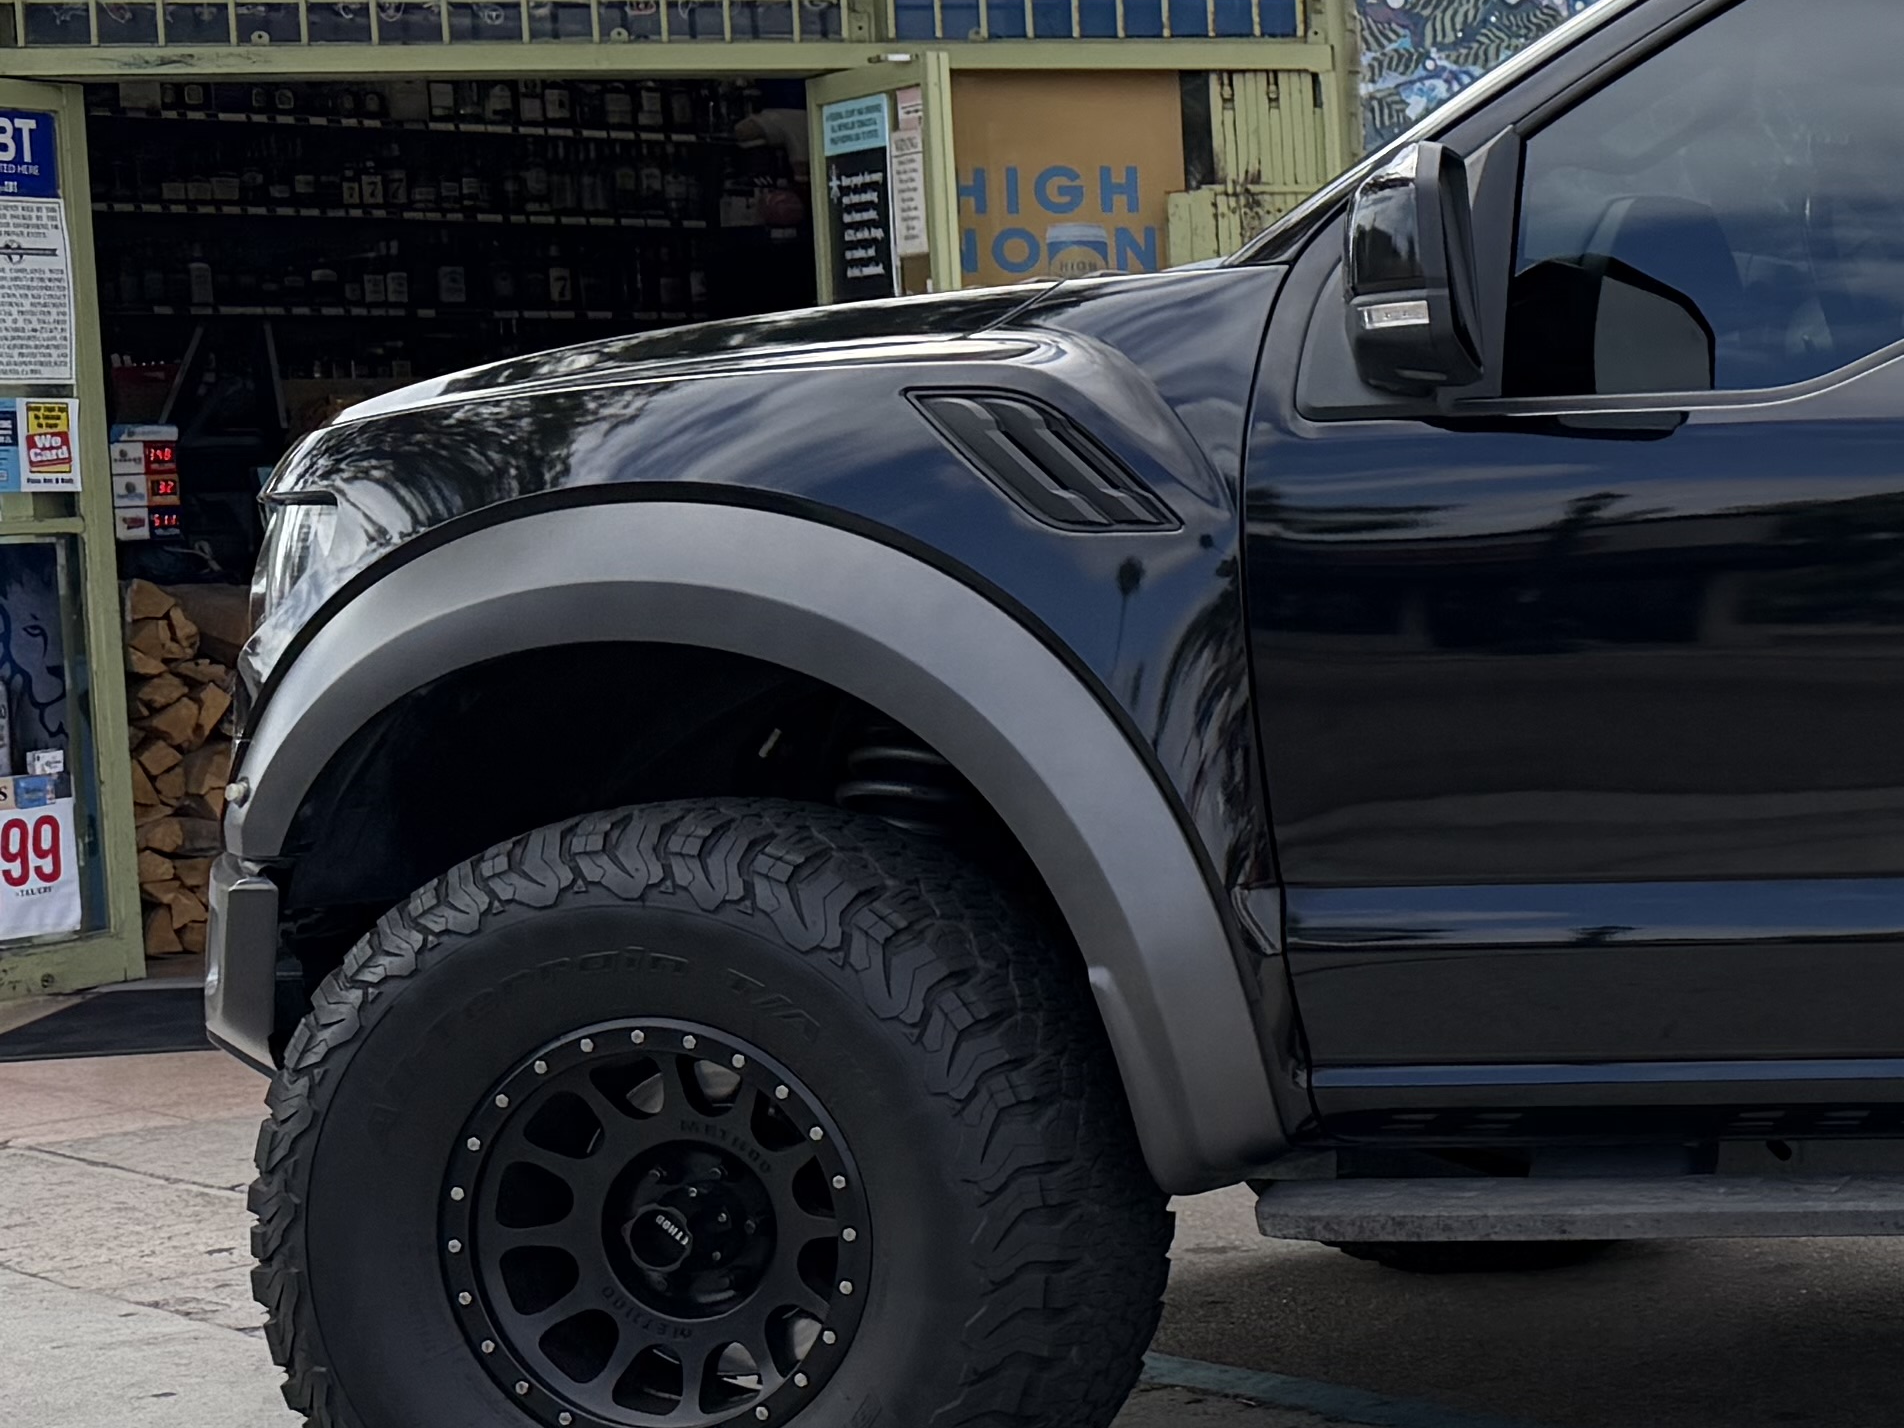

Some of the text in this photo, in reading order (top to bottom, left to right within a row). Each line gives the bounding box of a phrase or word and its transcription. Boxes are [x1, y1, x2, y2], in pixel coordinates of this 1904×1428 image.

[959, 165, 1139, 215] HIGH
[34, 435, 61, 447] We
[29, 446, 69, 462] Card
